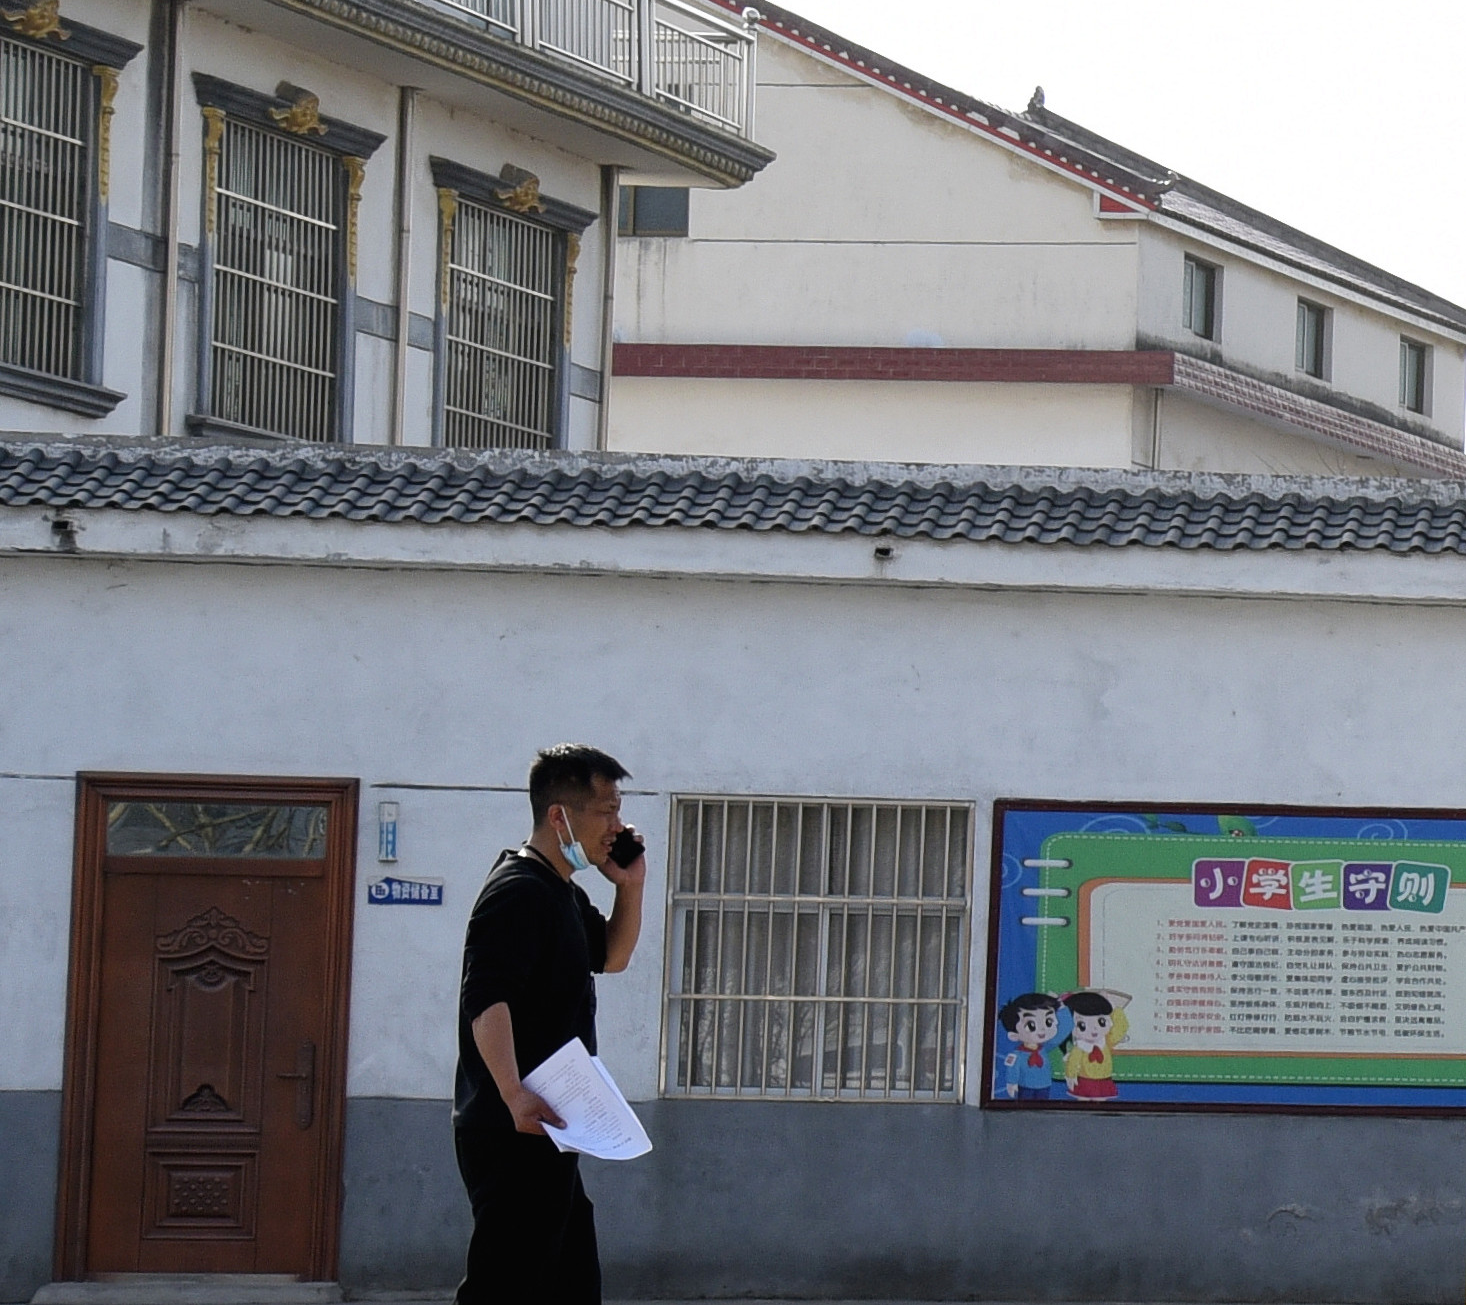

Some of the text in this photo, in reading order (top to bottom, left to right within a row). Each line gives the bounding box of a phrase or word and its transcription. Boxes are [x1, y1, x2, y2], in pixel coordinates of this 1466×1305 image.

[1200, 866, 1436, 906] 小学生守则
